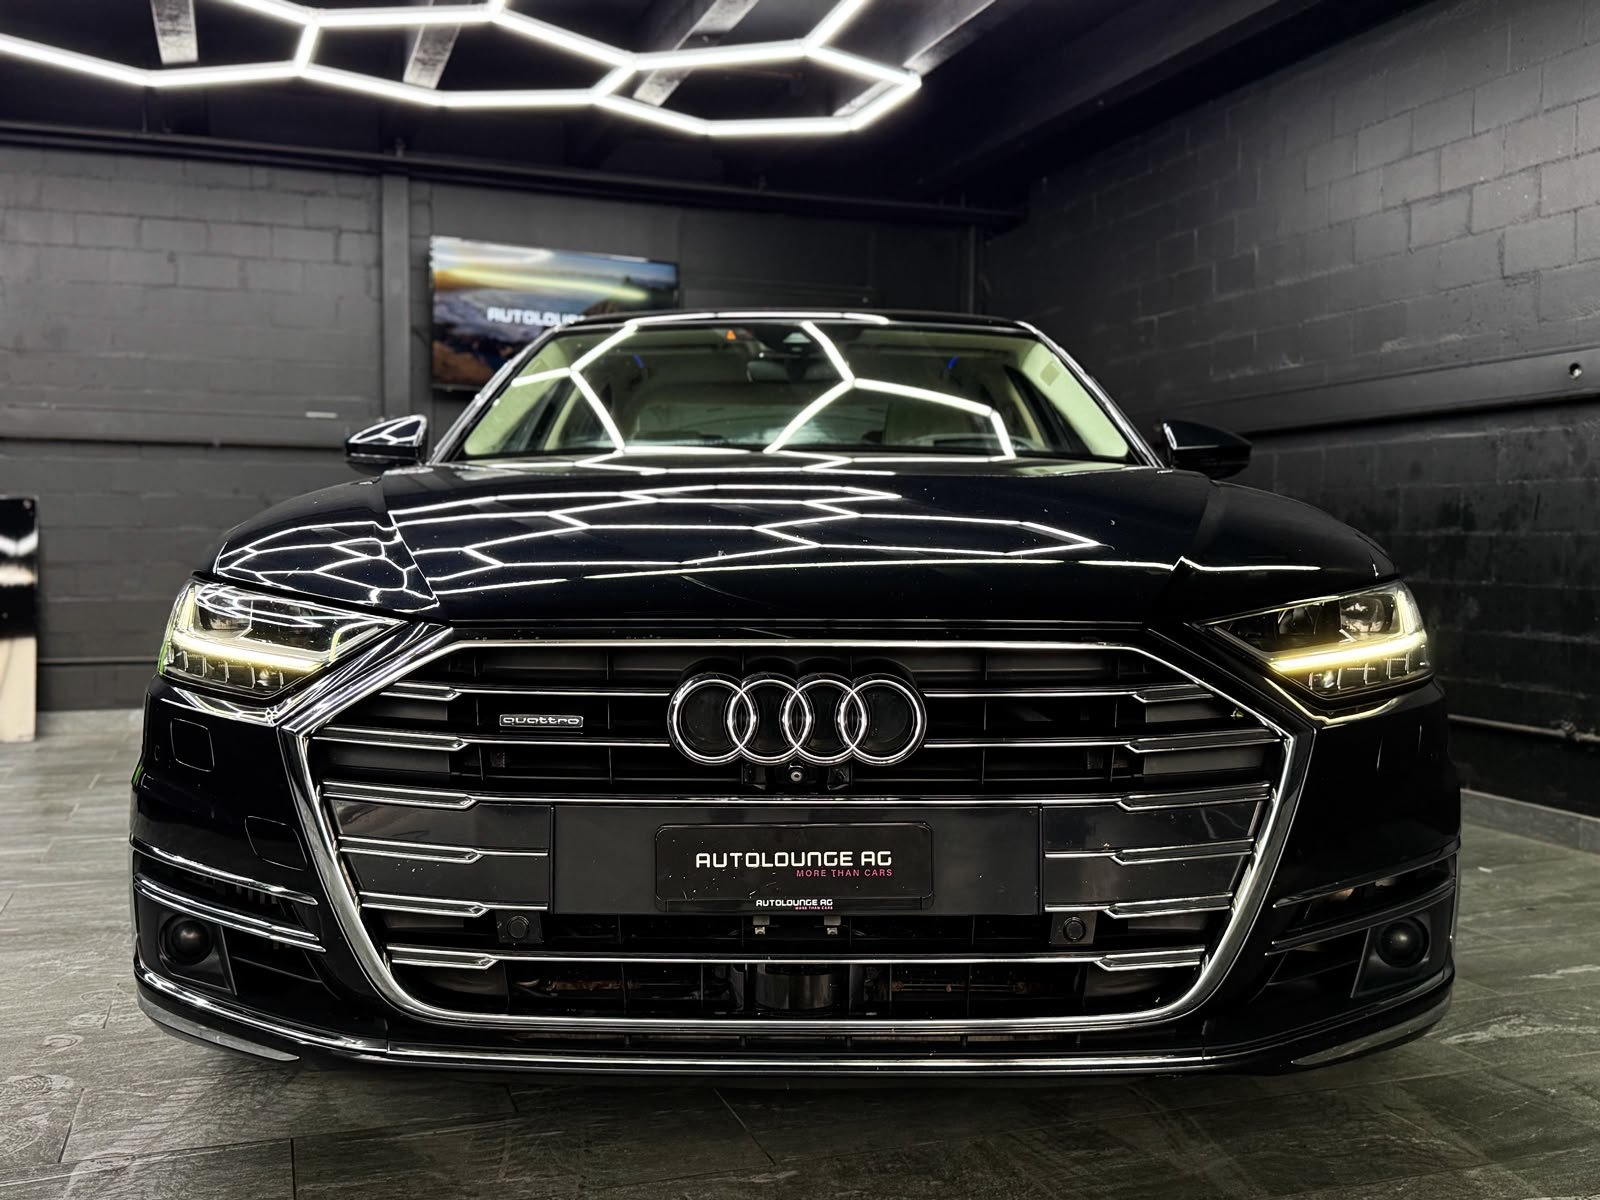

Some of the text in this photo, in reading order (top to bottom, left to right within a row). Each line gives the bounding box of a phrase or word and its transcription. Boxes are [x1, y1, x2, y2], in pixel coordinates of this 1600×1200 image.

[502, 716, 580, 726] quattro
[695, 850, 892, 868] AUTOLOUNGE AG
[796, 868, 893, 878] MORE THAN CARS
